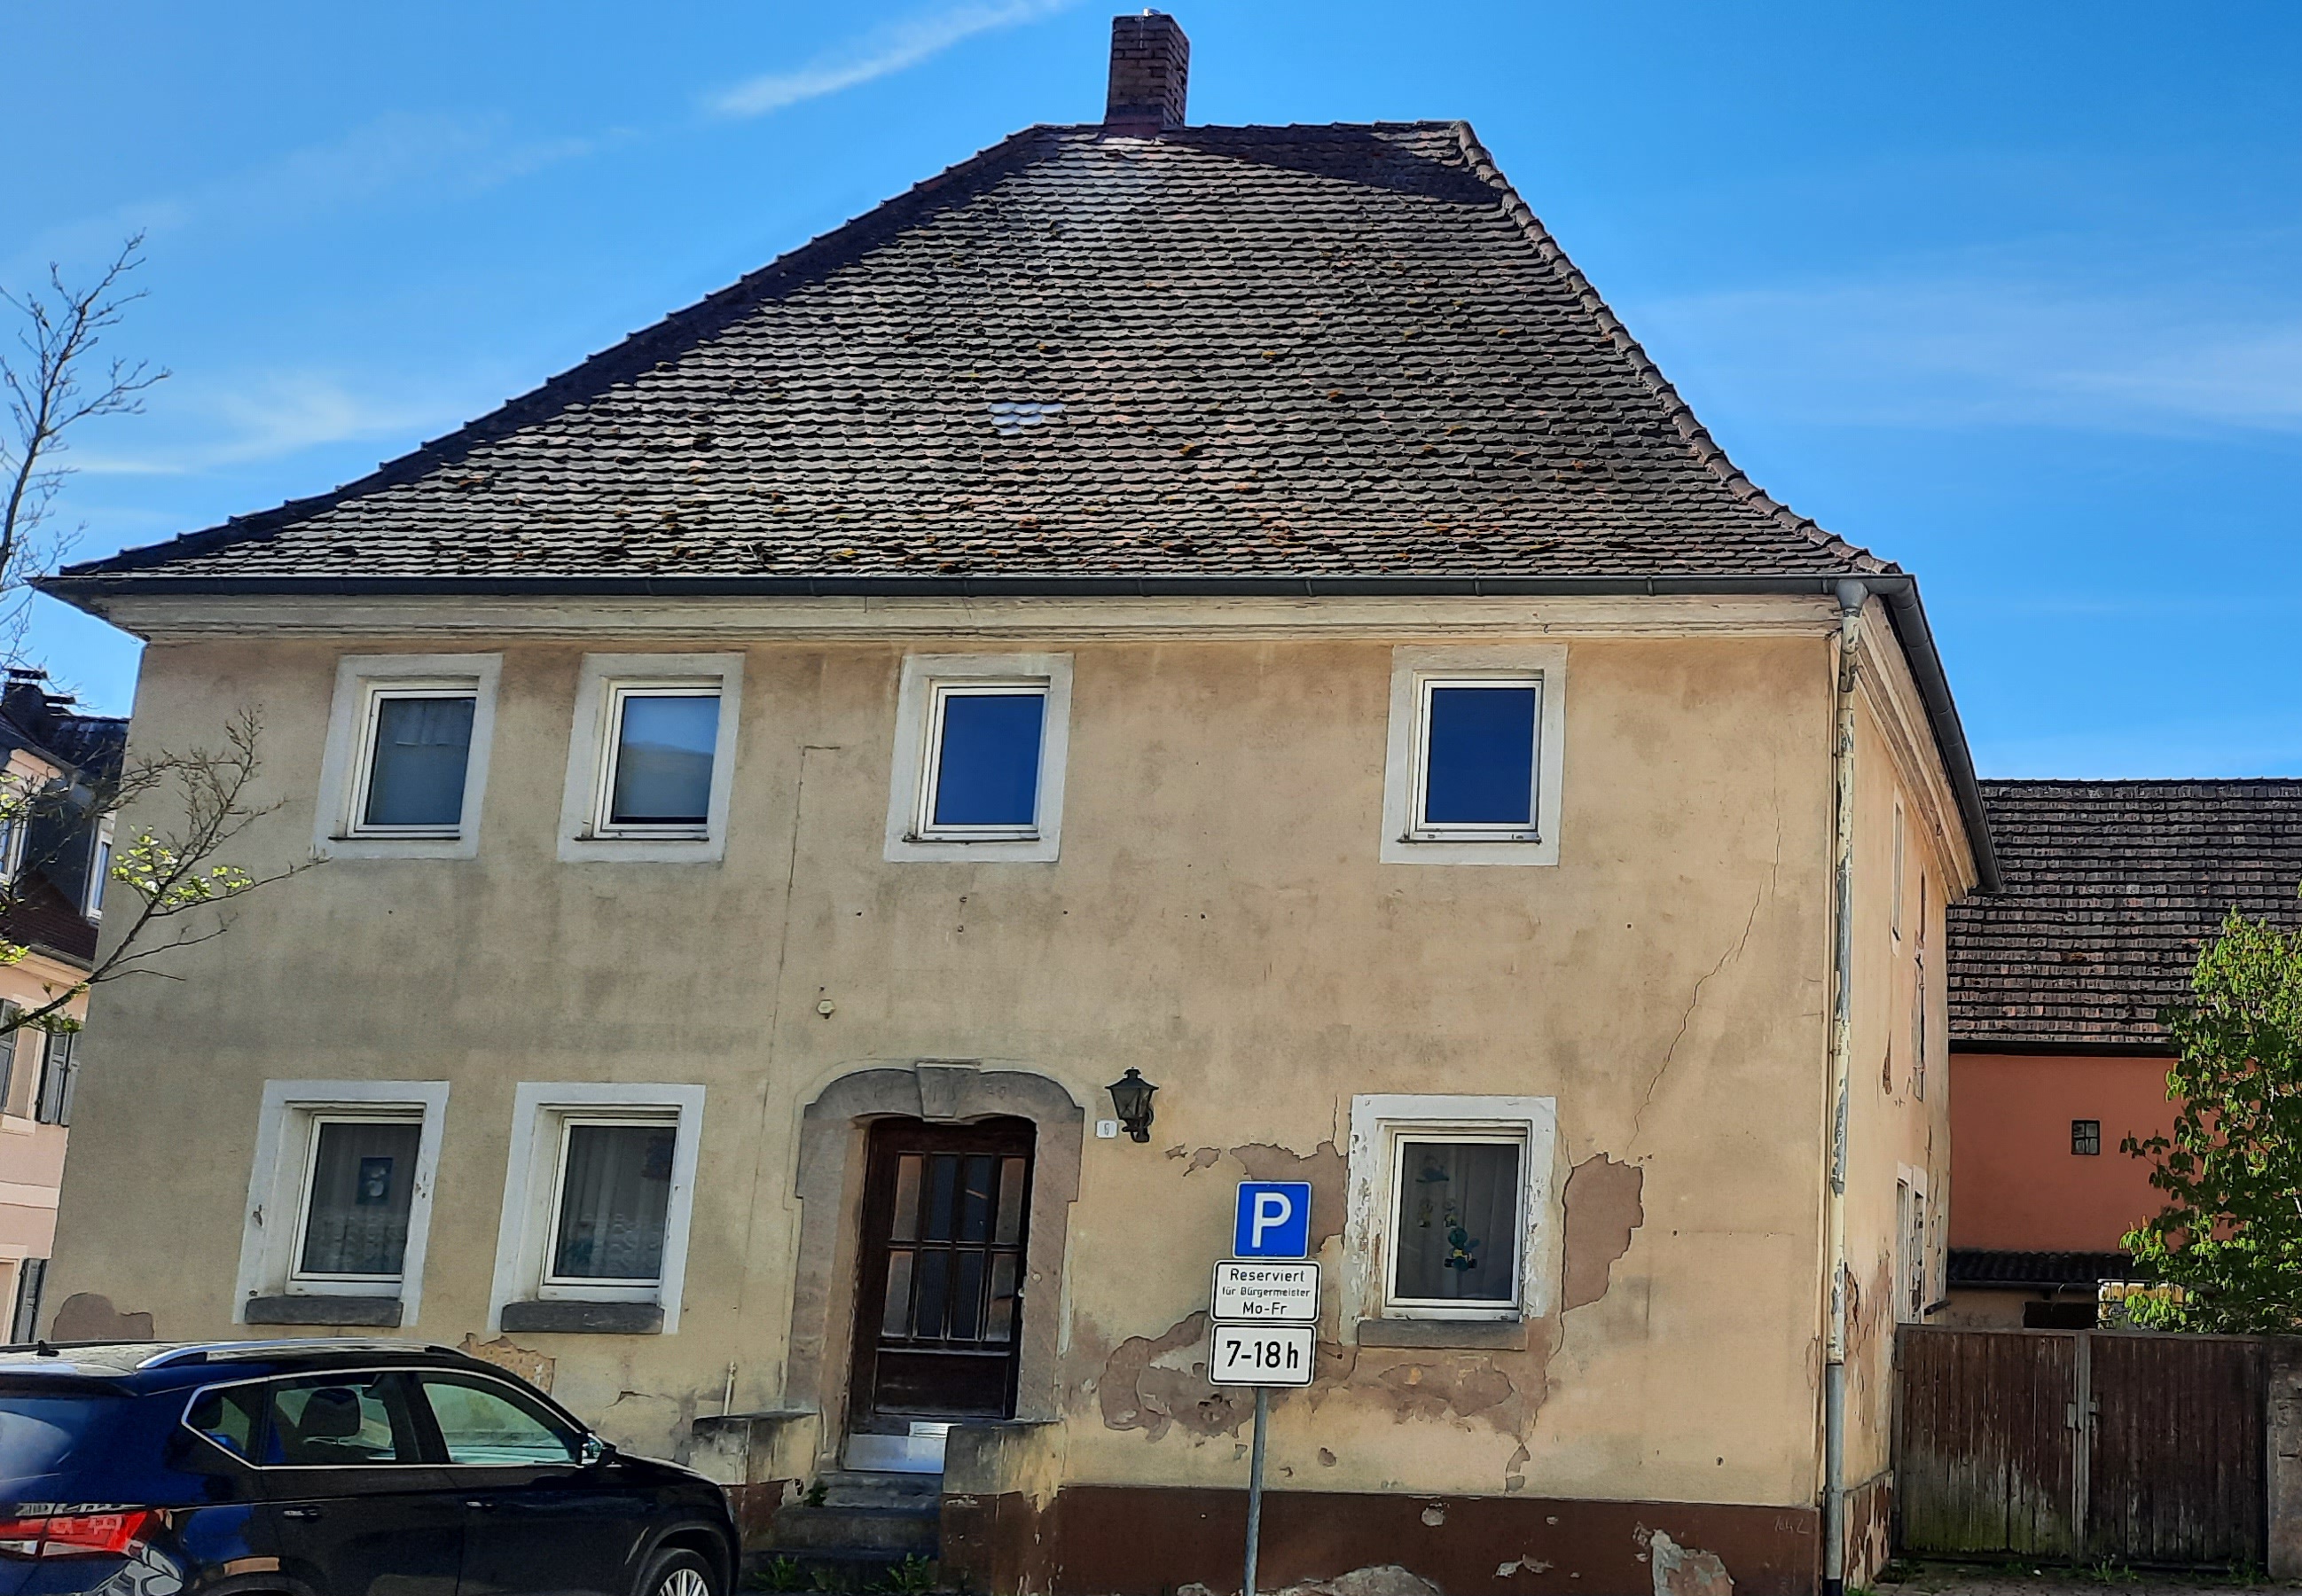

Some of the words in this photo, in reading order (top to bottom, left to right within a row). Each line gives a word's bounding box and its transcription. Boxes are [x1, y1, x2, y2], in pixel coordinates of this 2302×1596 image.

[1251, 1193, 1292, 1248] P
[1230, 1268, 1304, 1282] Reserviert
[1222, 1287, 1236, 1295] für
[1241, 1287, 1311, 1298] Bürgermeister
[1242, 1302, 1288, 1315] Mo-Fr
